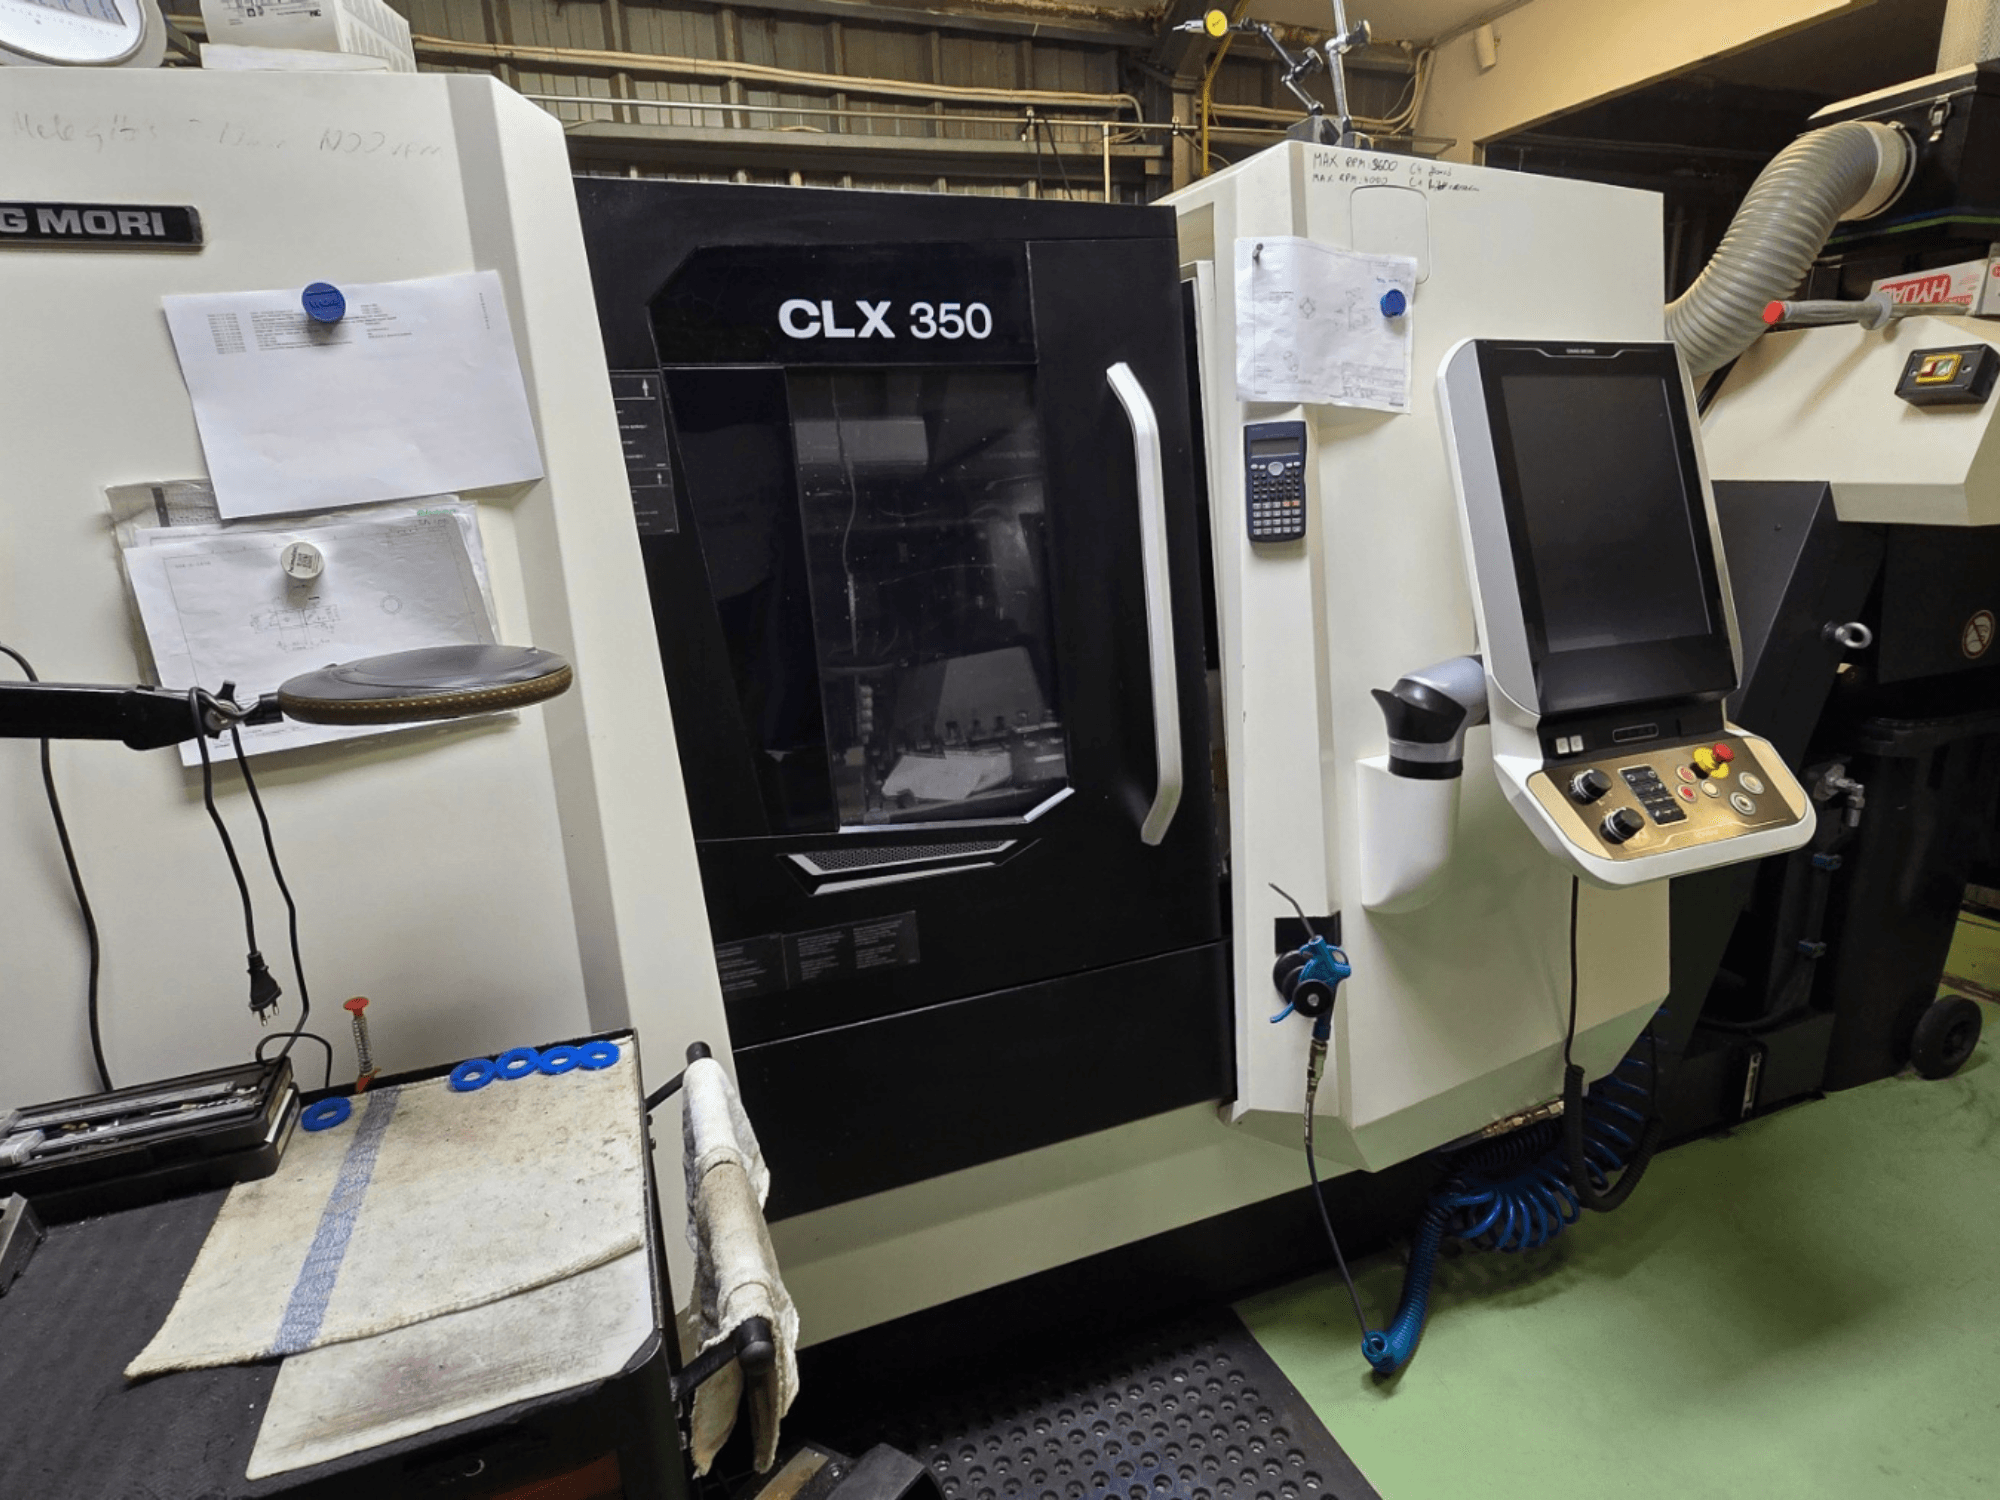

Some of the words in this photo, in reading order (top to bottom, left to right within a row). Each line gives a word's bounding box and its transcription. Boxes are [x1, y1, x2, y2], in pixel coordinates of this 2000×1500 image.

[1313, 152, 1338, 169] MAX
[1312, 172, 1334, 183] MAX
[36, 208, 166, 236] MORI
[778, 298, 896, 339] CLX
[909, 301, 993, 340] 350
